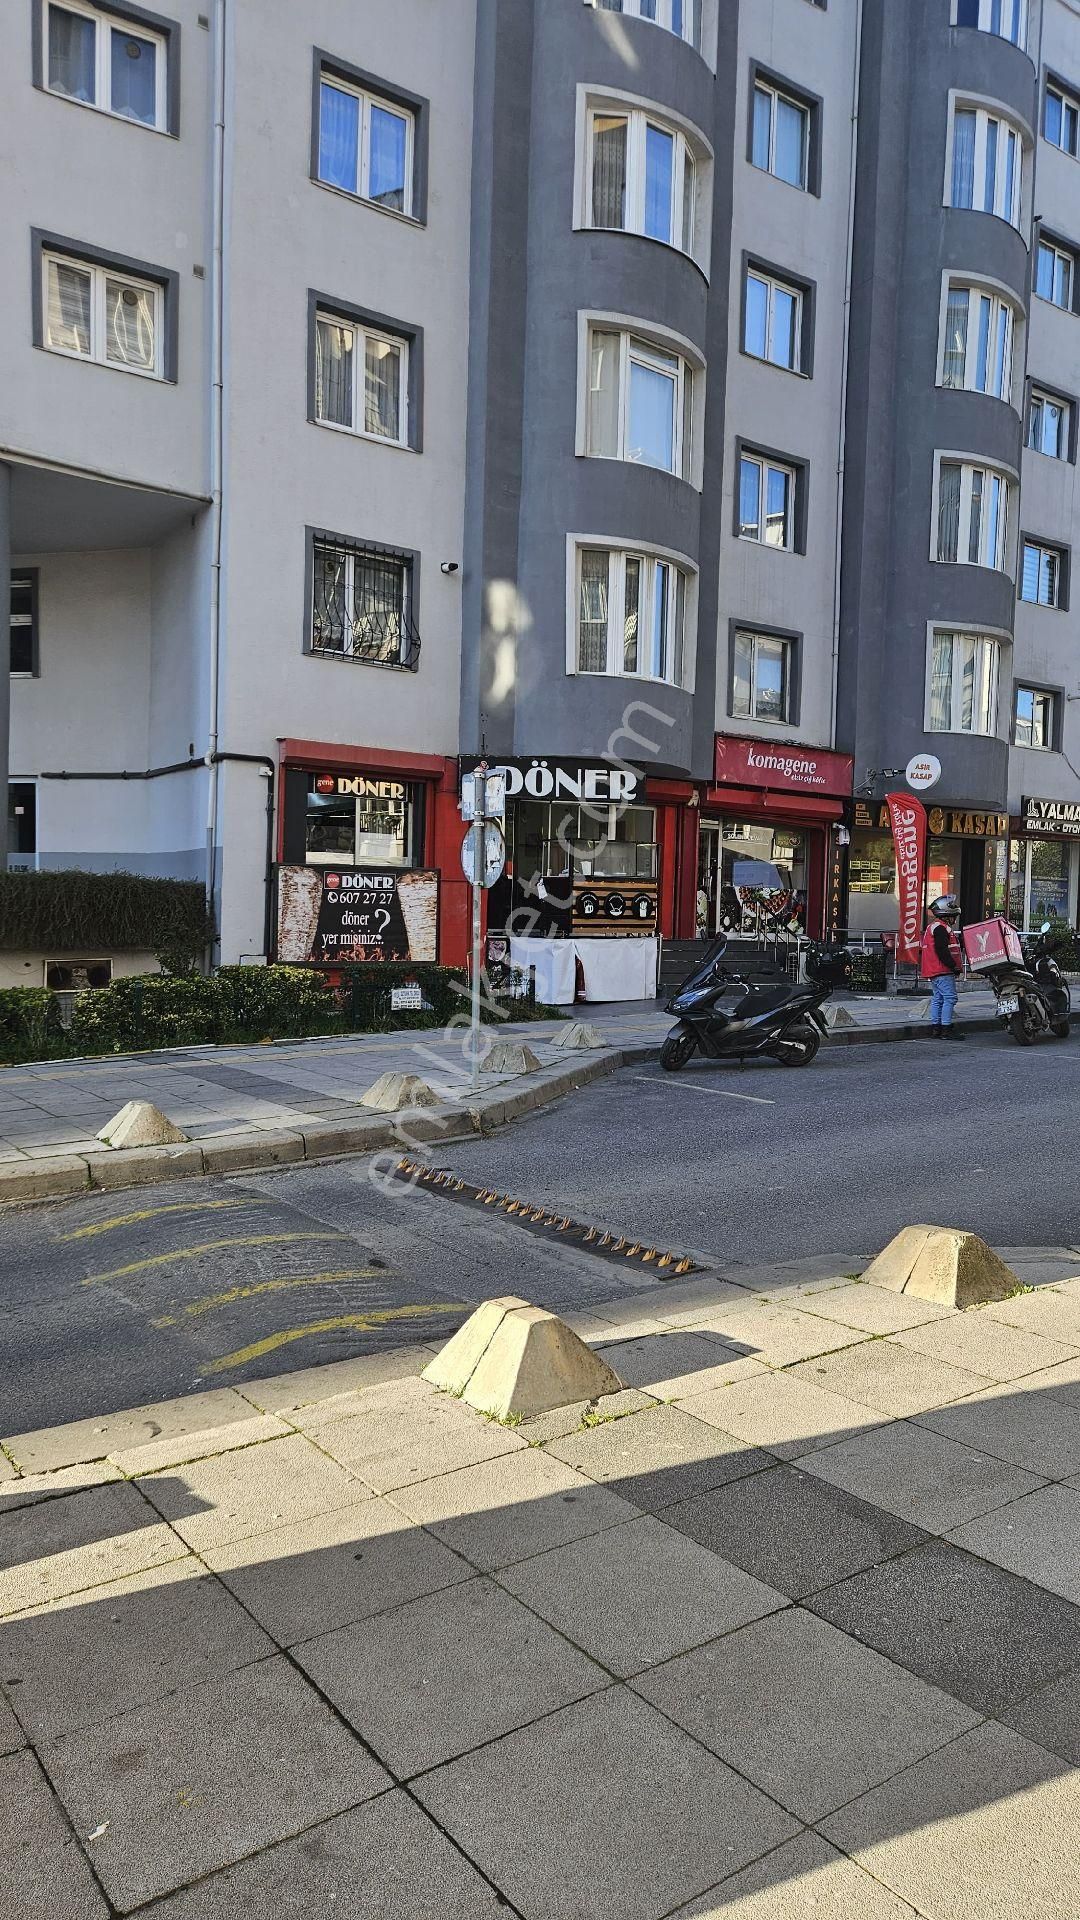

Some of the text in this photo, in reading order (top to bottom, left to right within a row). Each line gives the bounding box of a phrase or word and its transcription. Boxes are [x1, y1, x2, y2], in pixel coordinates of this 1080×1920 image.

[747, 748, 816, 776] komagene
[338, 777, 404, 799] DÖNER
[496, 760, 637, 800] DÖNER
[952, 812, 1006, 836] KASAP
[1026, 820, 1055, 831] EMLAK
[342, 874, 393, 889] DÖNER
[340, 892, 393, 904] 607 27 27
[341, 910, 370, 925] döner
[322, 933, 339, 949] yer
